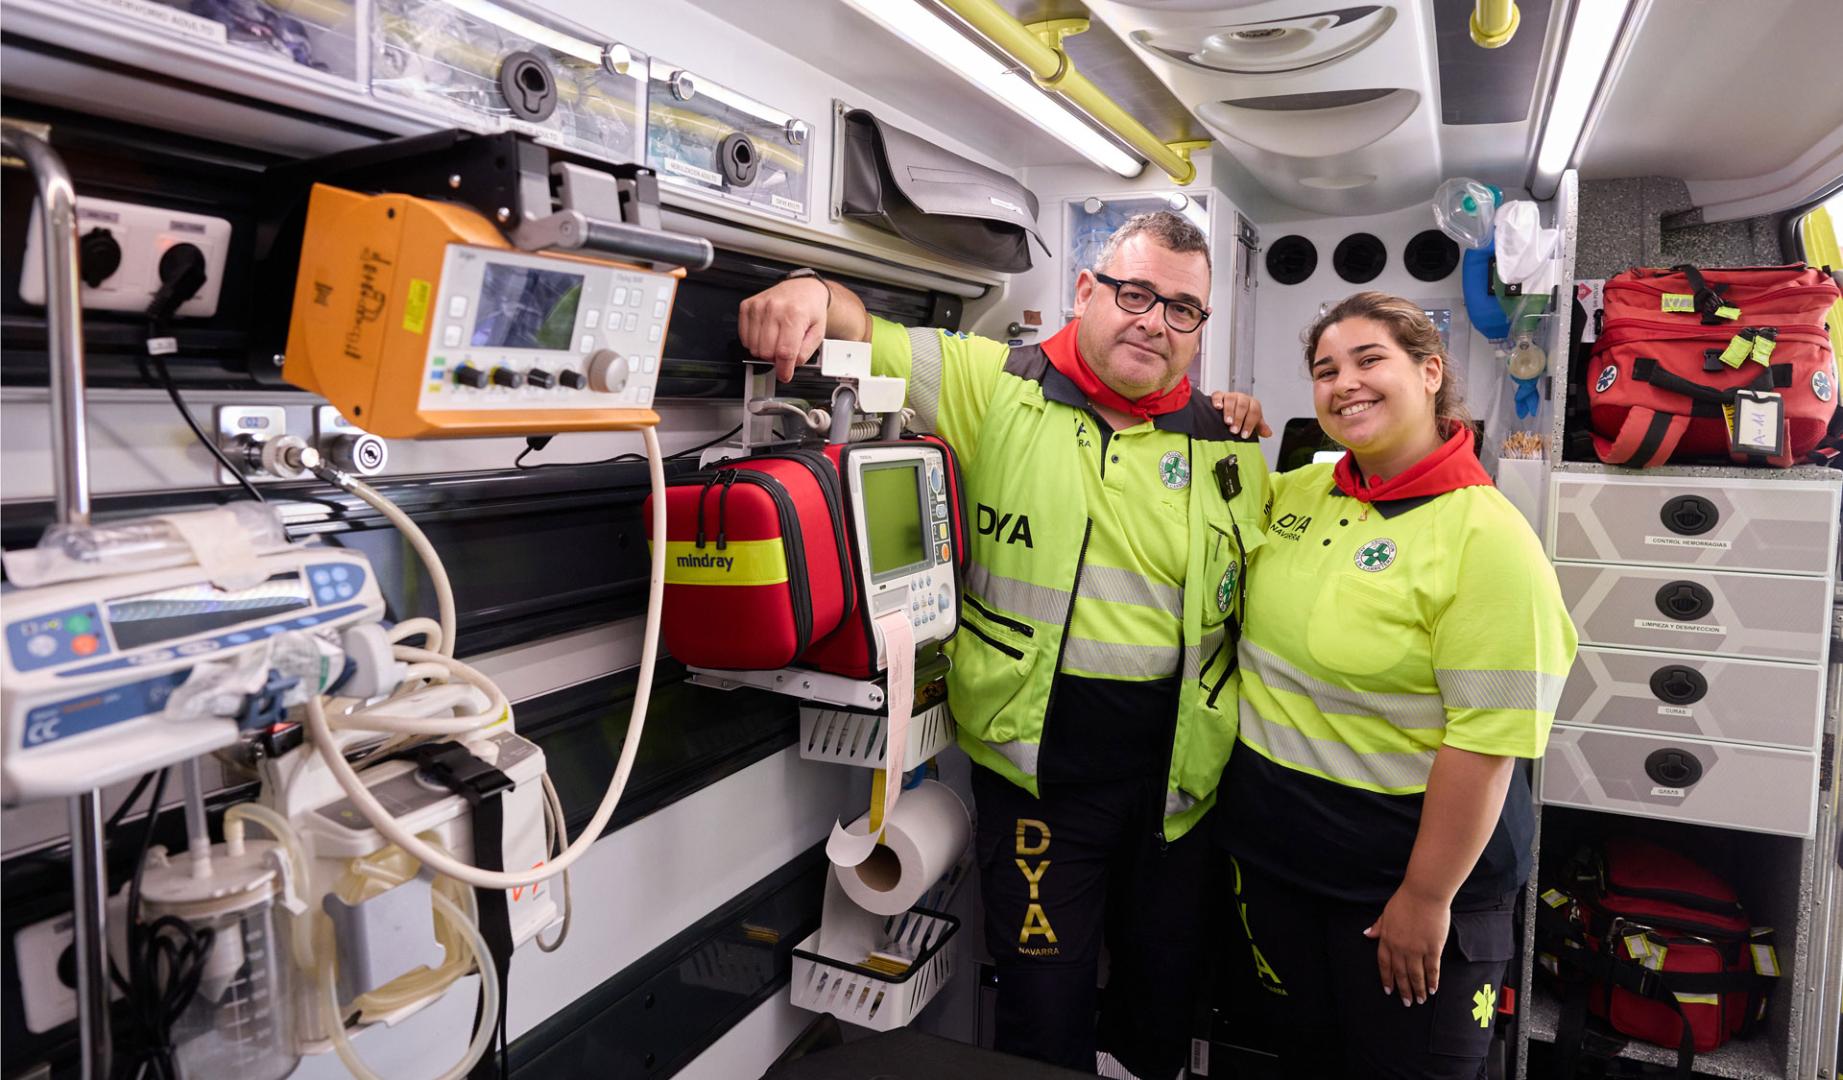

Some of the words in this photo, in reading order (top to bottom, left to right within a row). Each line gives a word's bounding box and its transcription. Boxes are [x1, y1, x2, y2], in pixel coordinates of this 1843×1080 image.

[976, 502, 1034, 549] DYA
[1682, 539, 1728, 548] HEMORRAGIAS
[676, 553, 734, 572] mindray
[1641, 621, 1669, 629] LIMPIEZA
[1675, 624, 1720, 633] DESINFECCION
[1015, 818, 1058, 943] DYA
[1018, 945, 1060, 957] NAVARRA
